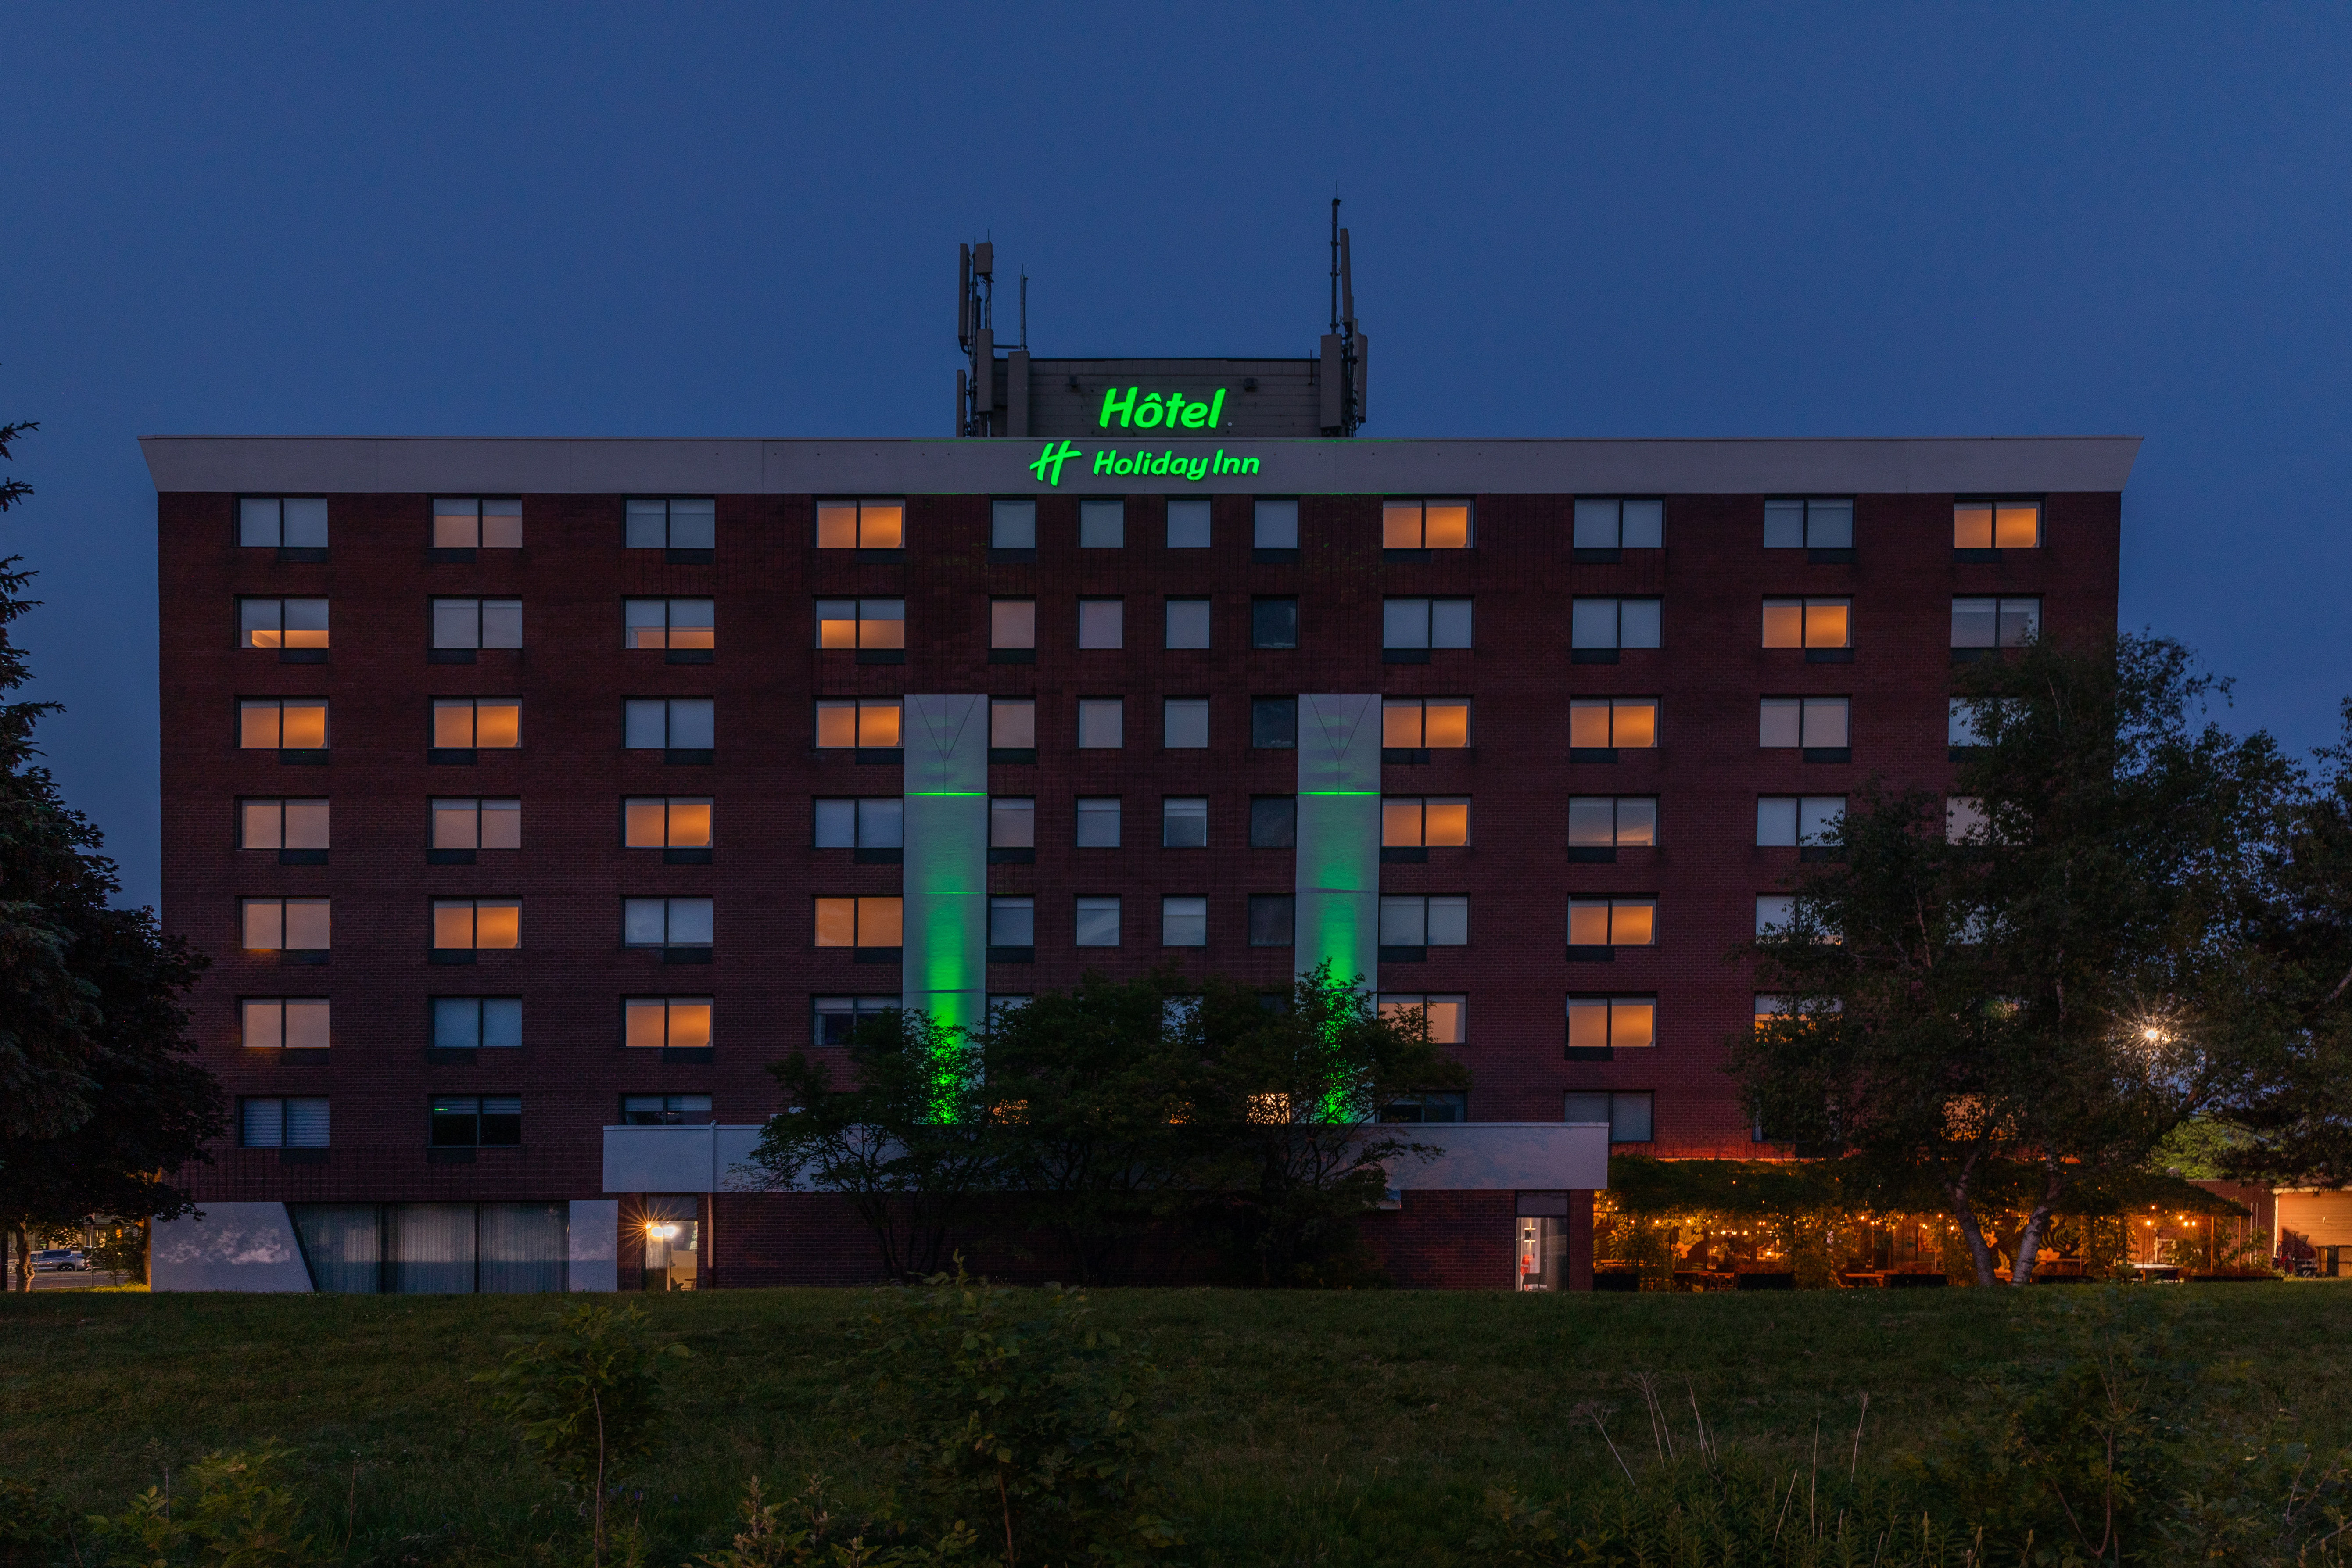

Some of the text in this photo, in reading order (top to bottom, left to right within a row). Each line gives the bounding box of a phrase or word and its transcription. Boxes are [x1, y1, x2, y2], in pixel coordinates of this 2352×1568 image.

[1099, 387, 1226, 428] Hôtel
[1093, 449, 1260, 481] Holiday Inn
